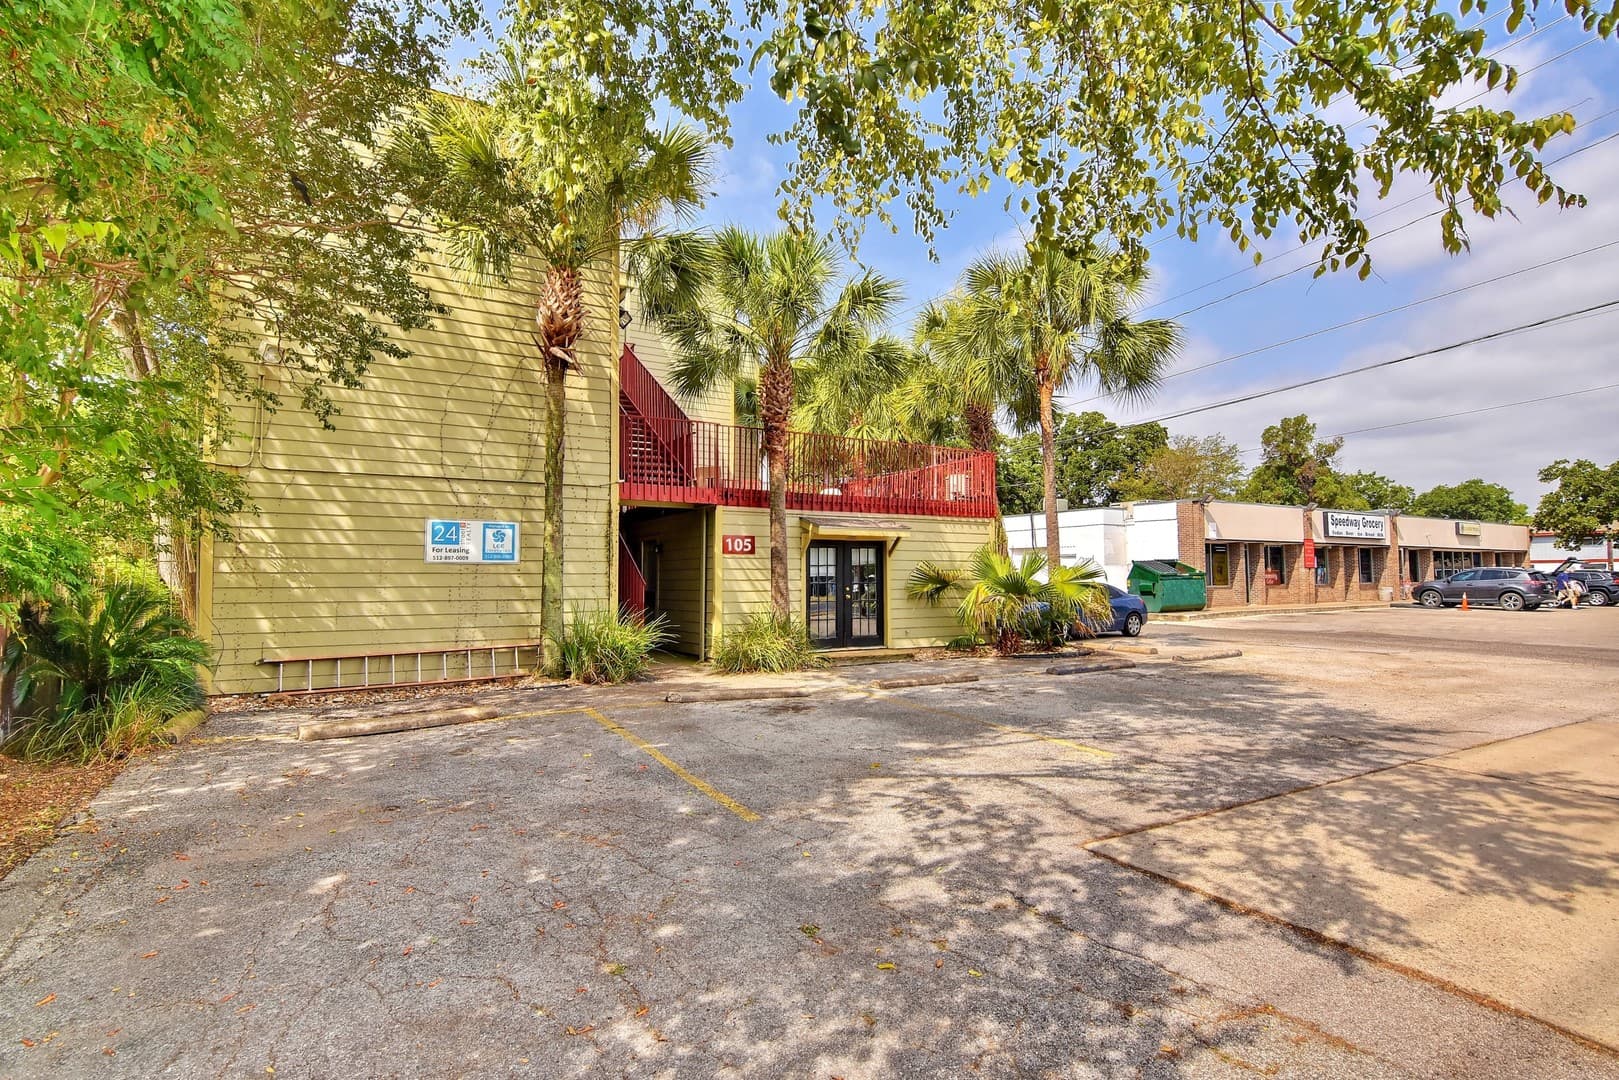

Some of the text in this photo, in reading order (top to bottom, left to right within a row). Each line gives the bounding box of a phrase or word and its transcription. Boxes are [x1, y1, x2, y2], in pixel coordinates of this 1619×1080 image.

[1331, 514, 1383, 531] Speedway Grocery
[434, 525, 457, 542] 24
[445, 546, 470, 555] Leasing
[725, 537, 752, 552] 105
